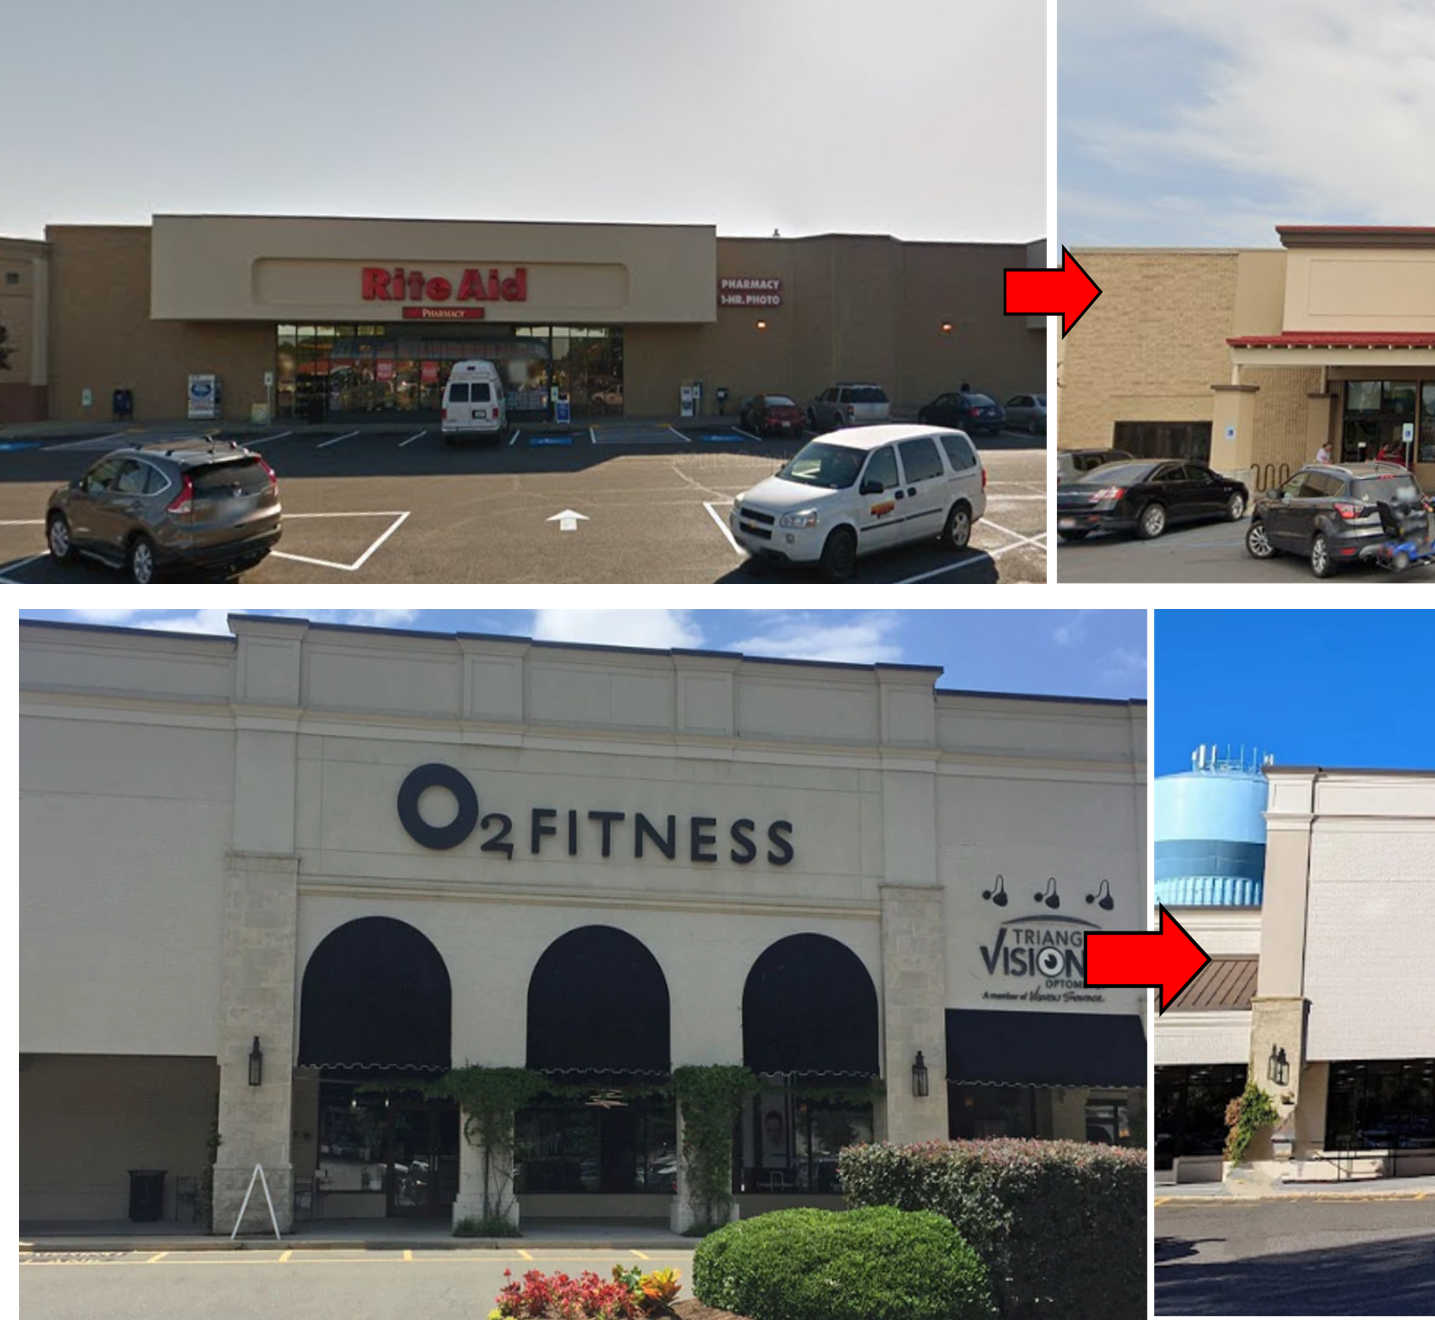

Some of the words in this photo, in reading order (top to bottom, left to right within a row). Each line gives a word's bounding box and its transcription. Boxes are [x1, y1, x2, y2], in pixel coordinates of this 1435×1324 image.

[362, 267, 452, 302] Rite
[457, 267, 527, 302] Aid
[721, 279, 780, 289] PHARMACY
[746, 295, 780, 305] PHOTO
[531, 808, 794, 865] FITNESS
[1013, 929, 1084, 947] TRIANG
[980, 927, 1084, 978] VISION
